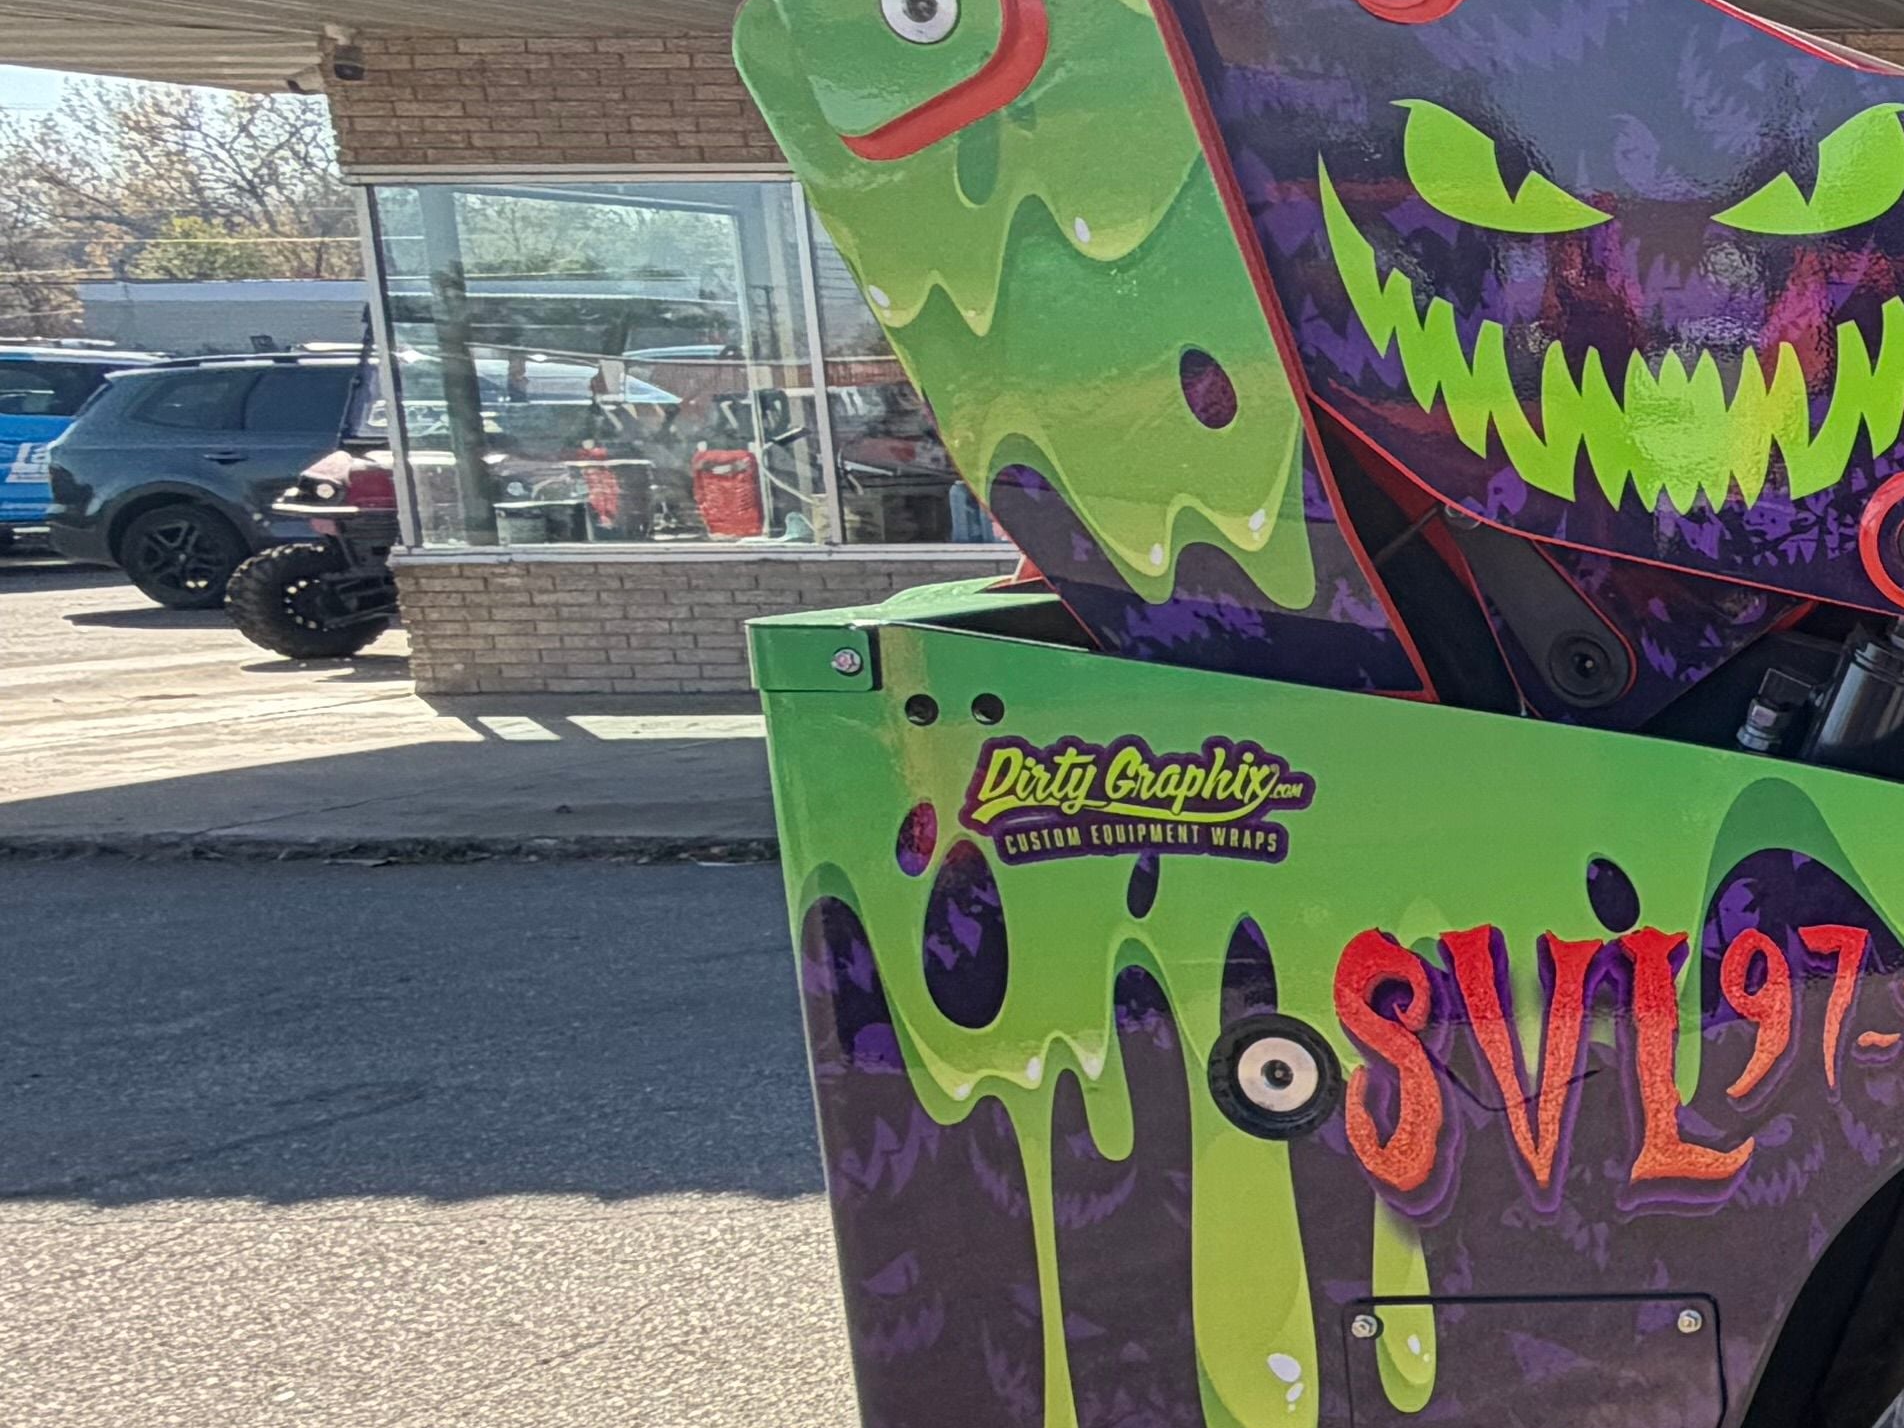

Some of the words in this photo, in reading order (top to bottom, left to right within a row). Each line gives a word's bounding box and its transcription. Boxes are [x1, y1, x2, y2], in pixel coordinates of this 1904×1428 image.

[978, 747, 1098, 814] Dirty
[1004, 826, 1082, 856] CUSTOM
[1091, 823, 1200, 845] EQUIPMENT
[1211, 825, 1279, 853] WRAPS
